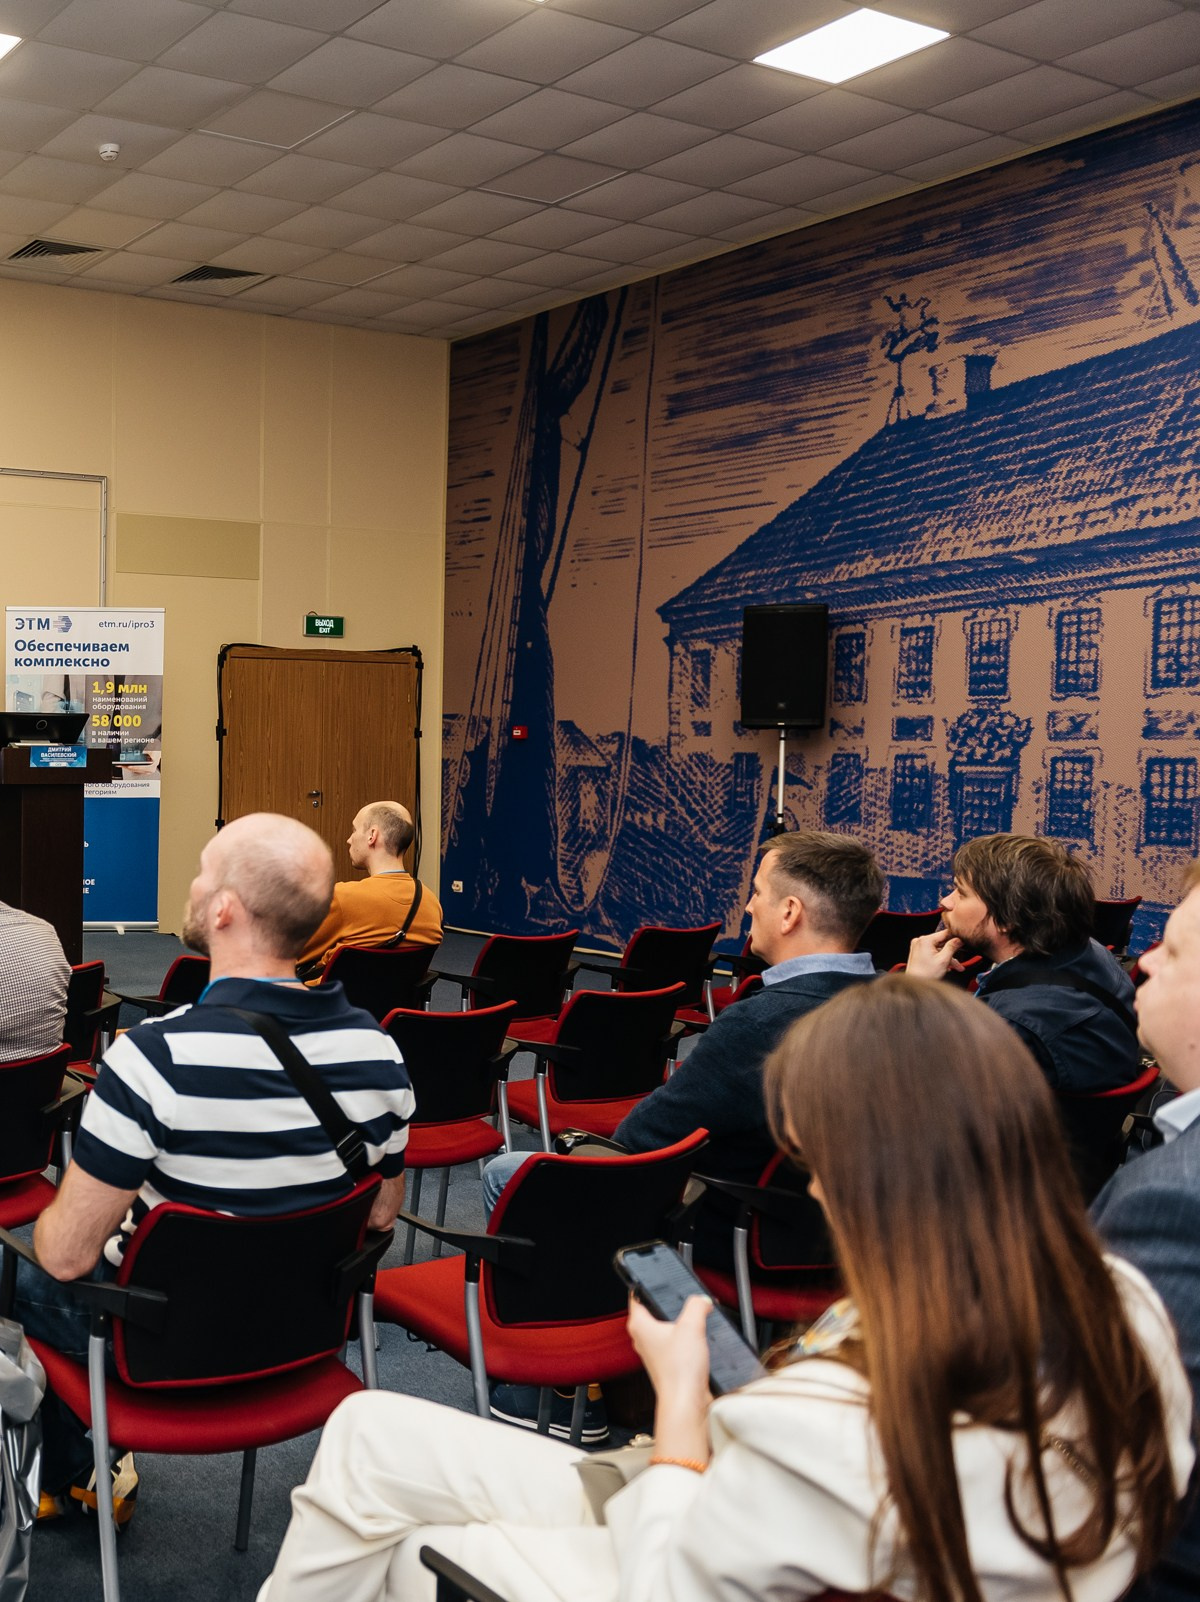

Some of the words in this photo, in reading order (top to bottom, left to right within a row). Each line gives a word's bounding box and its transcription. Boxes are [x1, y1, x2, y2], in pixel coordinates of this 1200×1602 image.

[15, 618, 50, 630] ЭТМ
[98, 620, 155, 630] etm.ru/ipro3
[315, 619, 334, 628] ВЫХОД
[14, 639, 129, 652] Обеспечиваем
[14, 657, 110, 667] комплексно
[92, 681, 115, 695] 1,9
[118, 684, 148, 694] млн
[92, 703, 146, 711] оборудования
[91, 714, 110, 727] 58
[113, 714, 142, 727] 000
